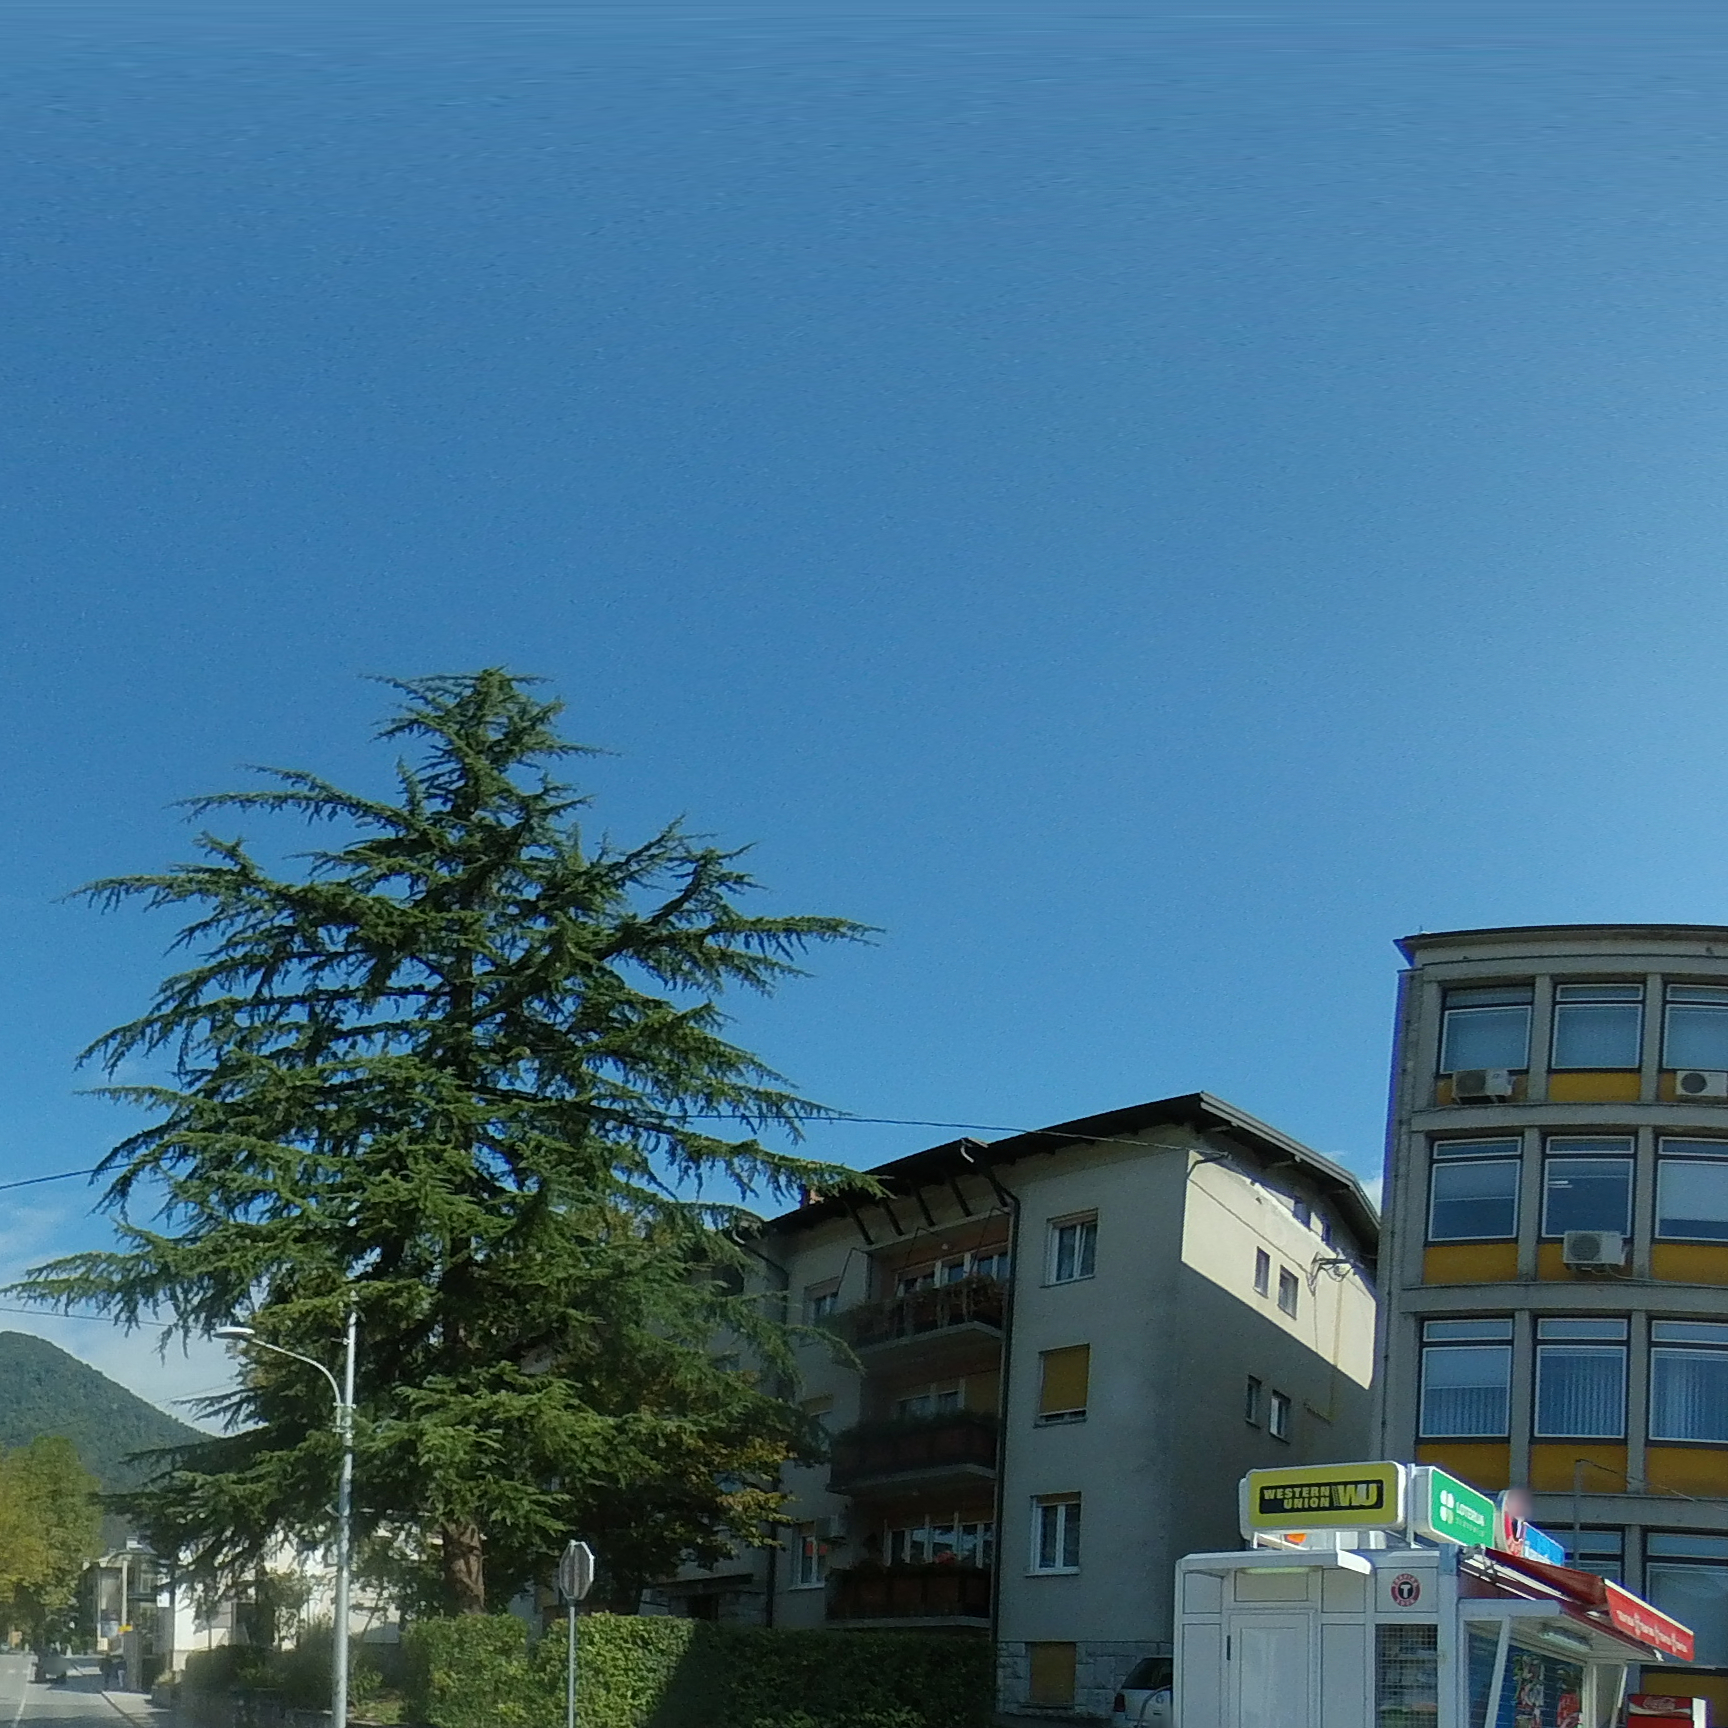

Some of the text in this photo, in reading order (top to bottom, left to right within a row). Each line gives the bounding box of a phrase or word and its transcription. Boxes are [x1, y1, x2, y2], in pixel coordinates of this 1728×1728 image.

[1263, 1485, 1330, 1500] WESTERN
[1283, 1497, 1330, 1510] UNION
[1400, 1584, 1411, 1599] T
